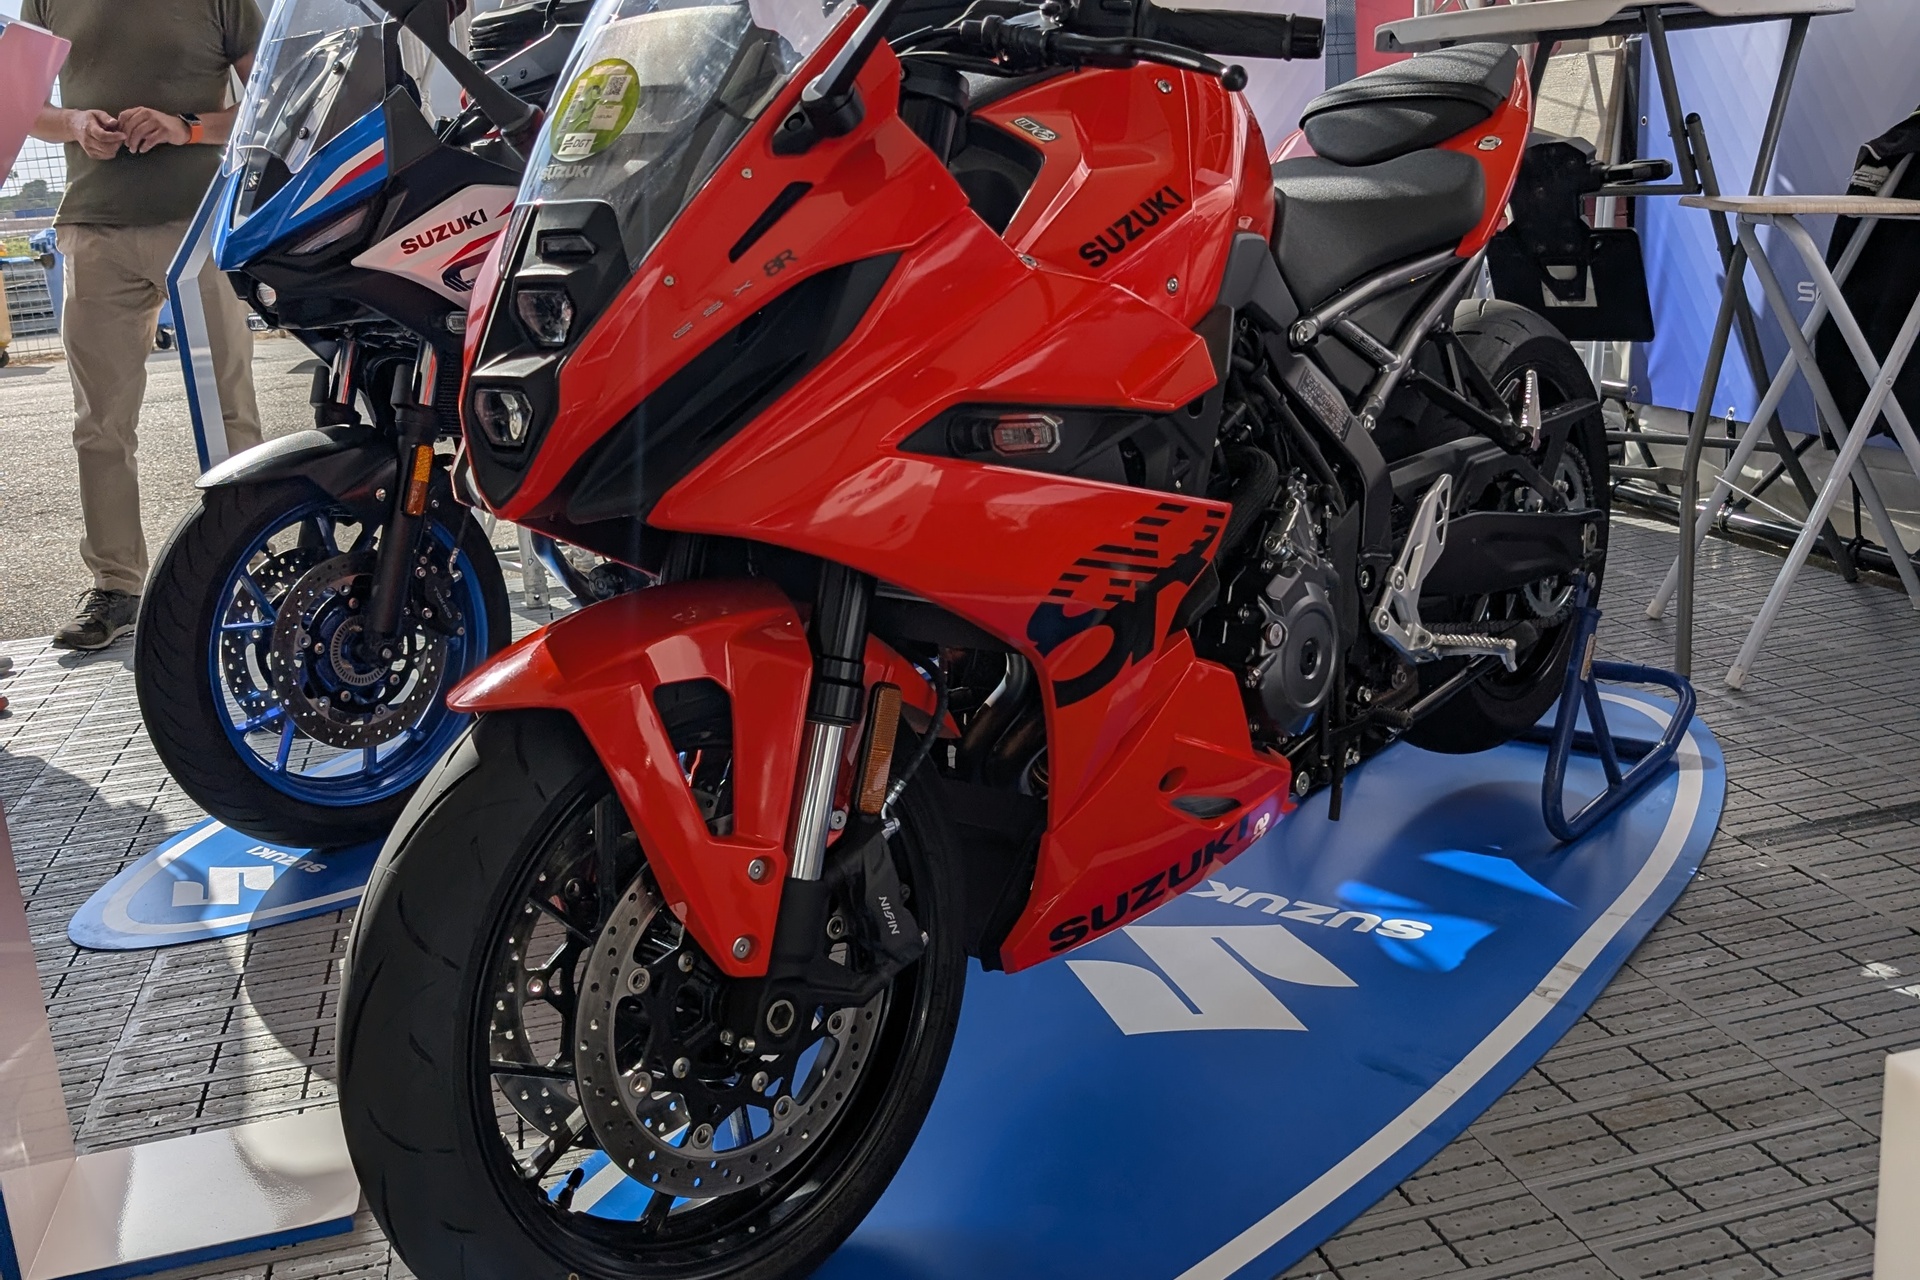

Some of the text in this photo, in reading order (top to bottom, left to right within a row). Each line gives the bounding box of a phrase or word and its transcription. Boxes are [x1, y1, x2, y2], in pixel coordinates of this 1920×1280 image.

[572, 139, 592, 148] DGT
[541, 164, 596, 180] SUZUKI
[400, 208, 488, 255] SUZUKI
[1078, 185, 1185, 268] SUZUKI
[246, 845, 327, 873] SUZUKI
[1048, 814, 1249, 953] SUZUKI
[878, 896, 900, 935] NISSIN
[1187, 879, 1433, 940] SUZUK
